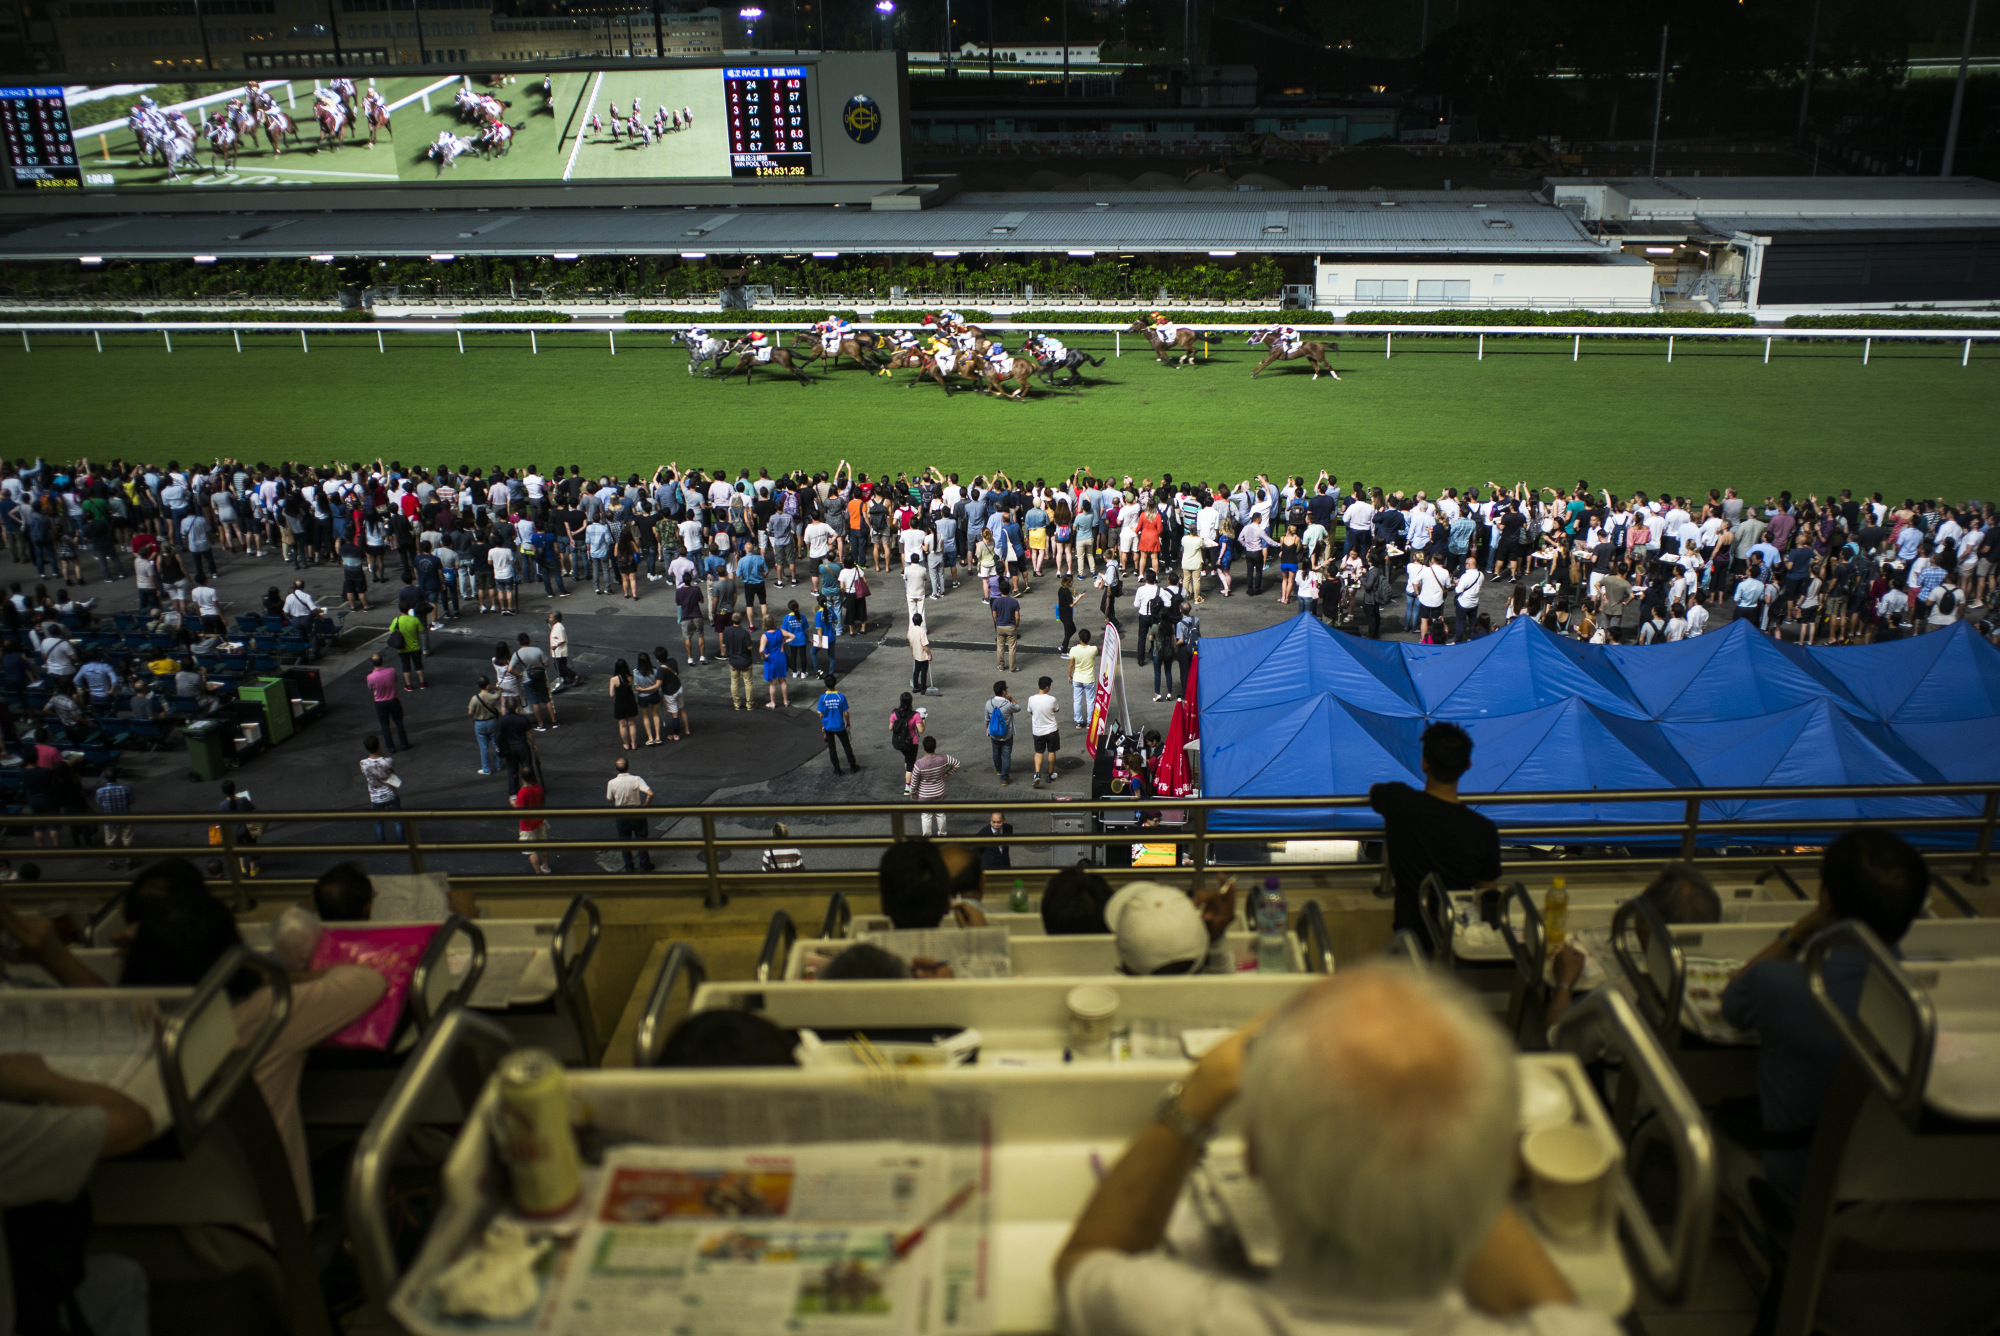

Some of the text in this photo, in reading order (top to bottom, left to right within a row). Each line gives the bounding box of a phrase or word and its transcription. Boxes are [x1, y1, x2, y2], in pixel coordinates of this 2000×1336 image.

[764, 69, 769, 77] 3
[746, 81, 756, 89] 24
[787, 80, 800, 88] 4.0
[746, 94, 759, 102] 4.2
[749, 106, 758, 114] 27
[734, 118, 740, 126] 4
[750, 118, 759, 126] 10
[774, 118, 783, 126] 10
[751, 131, 760, 139] 24
[790, 130, 803, 138] 6.0
[736, 142, 803, 151] 6 6.7 12 83
[49, 156, 59, 164] 12
[756, 167, 804, 176] $ 24,631,292
